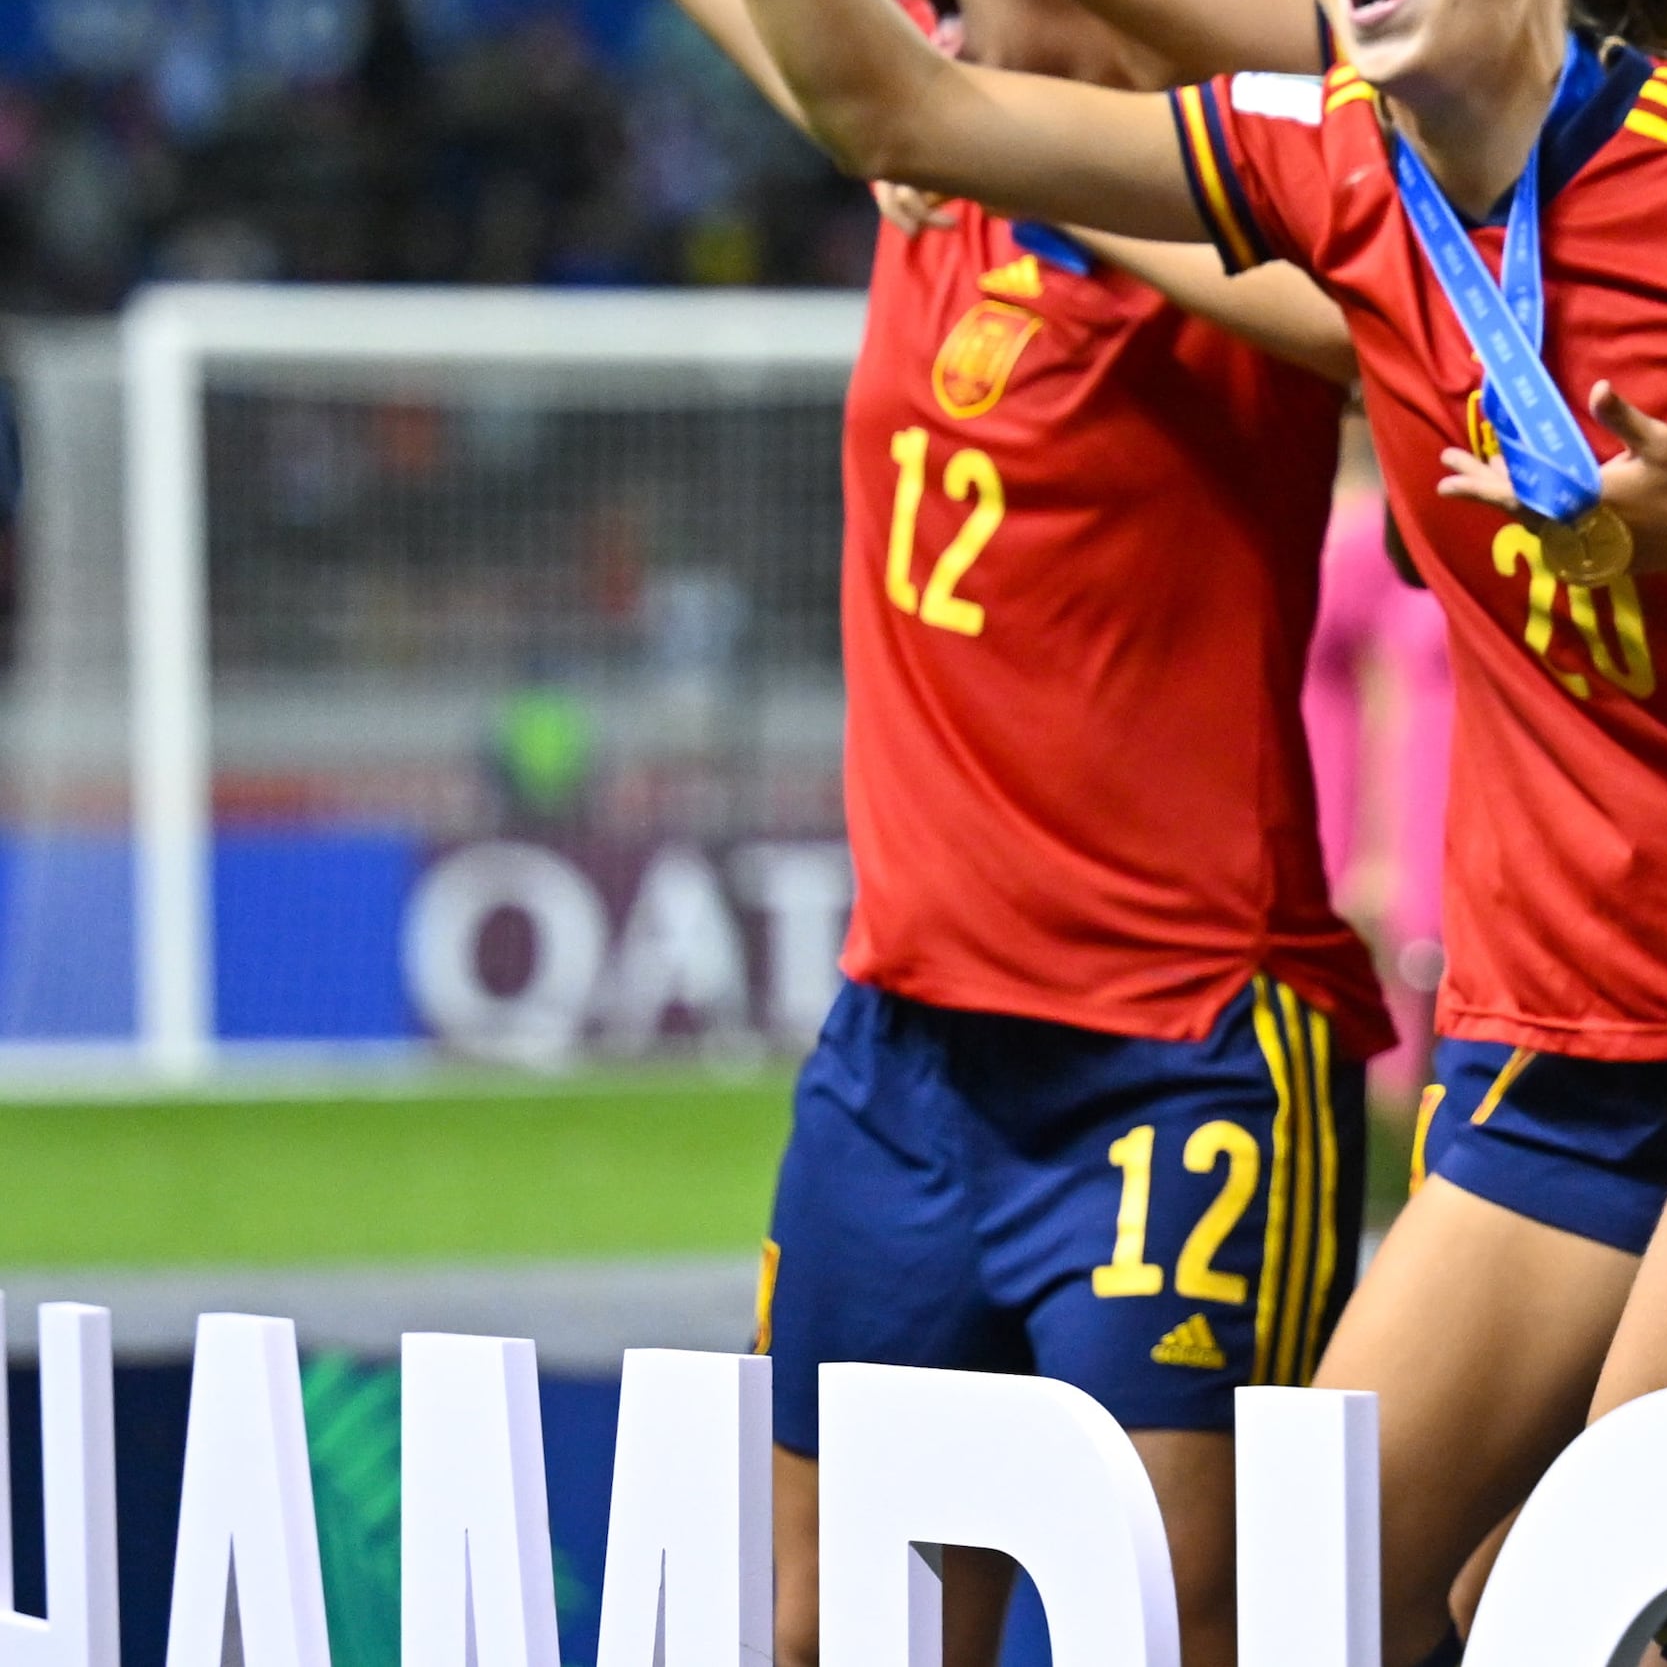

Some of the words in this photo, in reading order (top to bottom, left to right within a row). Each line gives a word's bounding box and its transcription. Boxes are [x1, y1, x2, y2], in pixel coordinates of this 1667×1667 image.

[885, 425, 1007, 637] 12
[1491, 523, 1656, 701] 20
[1092, 1119, 1261, 1305] 12
